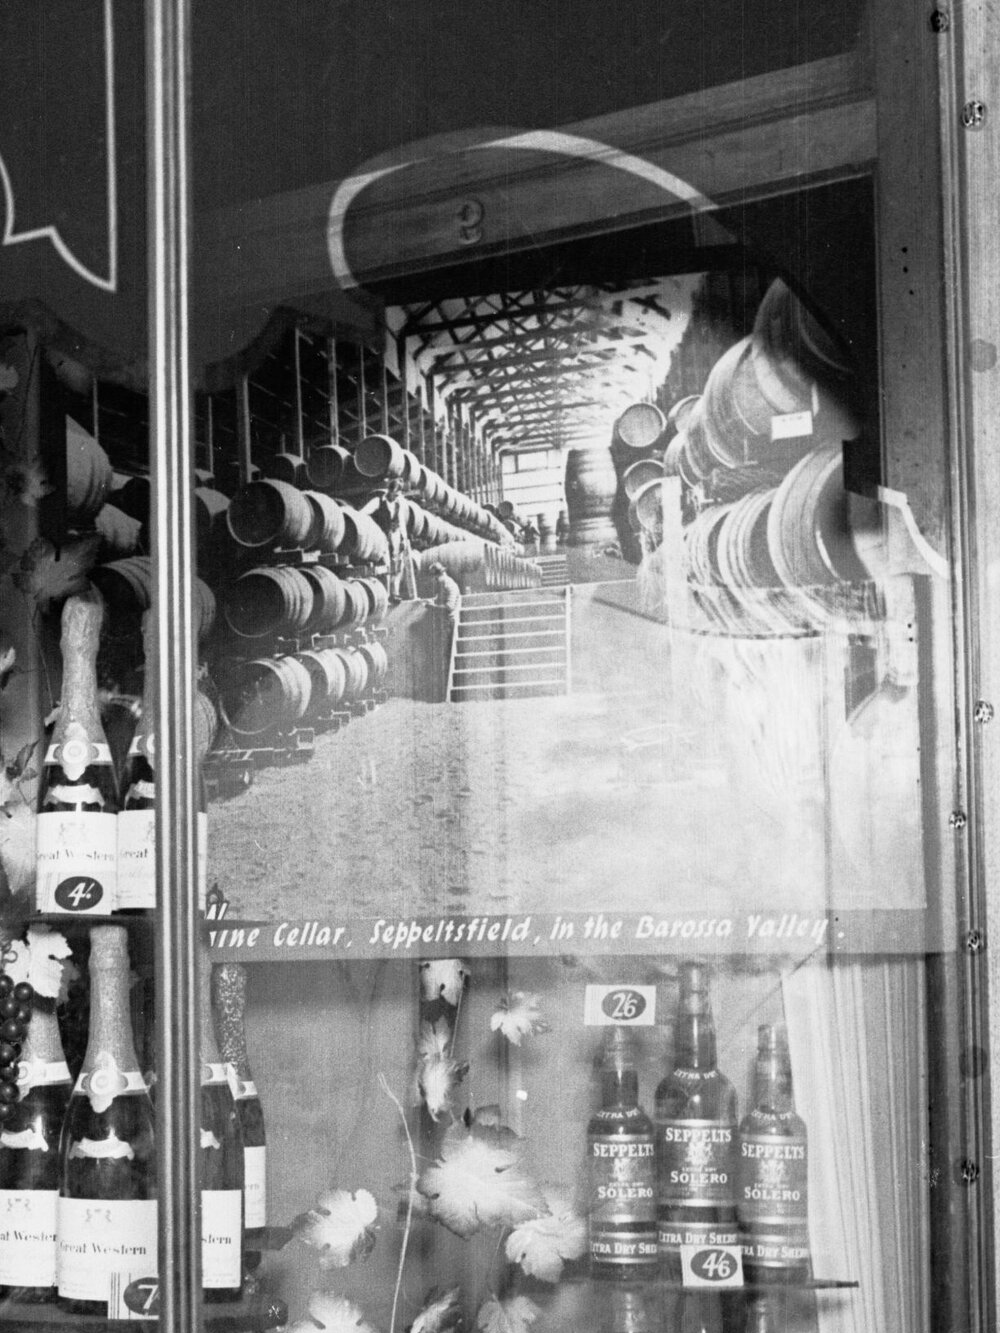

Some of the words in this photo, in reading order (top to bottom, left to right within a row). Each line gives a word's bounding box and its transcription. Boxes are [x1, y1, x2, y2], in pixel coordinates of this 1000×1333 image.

[274, 921, 352, 948] Cellar,
[369, 917, 540, 949] Seppeltsfield,
[549, 915, 575, 940] in
[583, 913, 624, 940] the
[634, 915, 734, 940] Barossa
[665, 1127, 732, 1143] SEPPELTS
[741, 1142, 805, 1160] SEPPELTS
[670, 1170, 728, 1184] SOLERO
[598, 1185, 653, 1199] SOLERO
[744, 1186, 801, 1202] SOLERO
[14, 1230, 57, 1242] Wester
[685, 1232, 706, 1245] DRY
[614, 1242, 636, 1254] DRY
[757, 1245, 779, 1258] DRY
